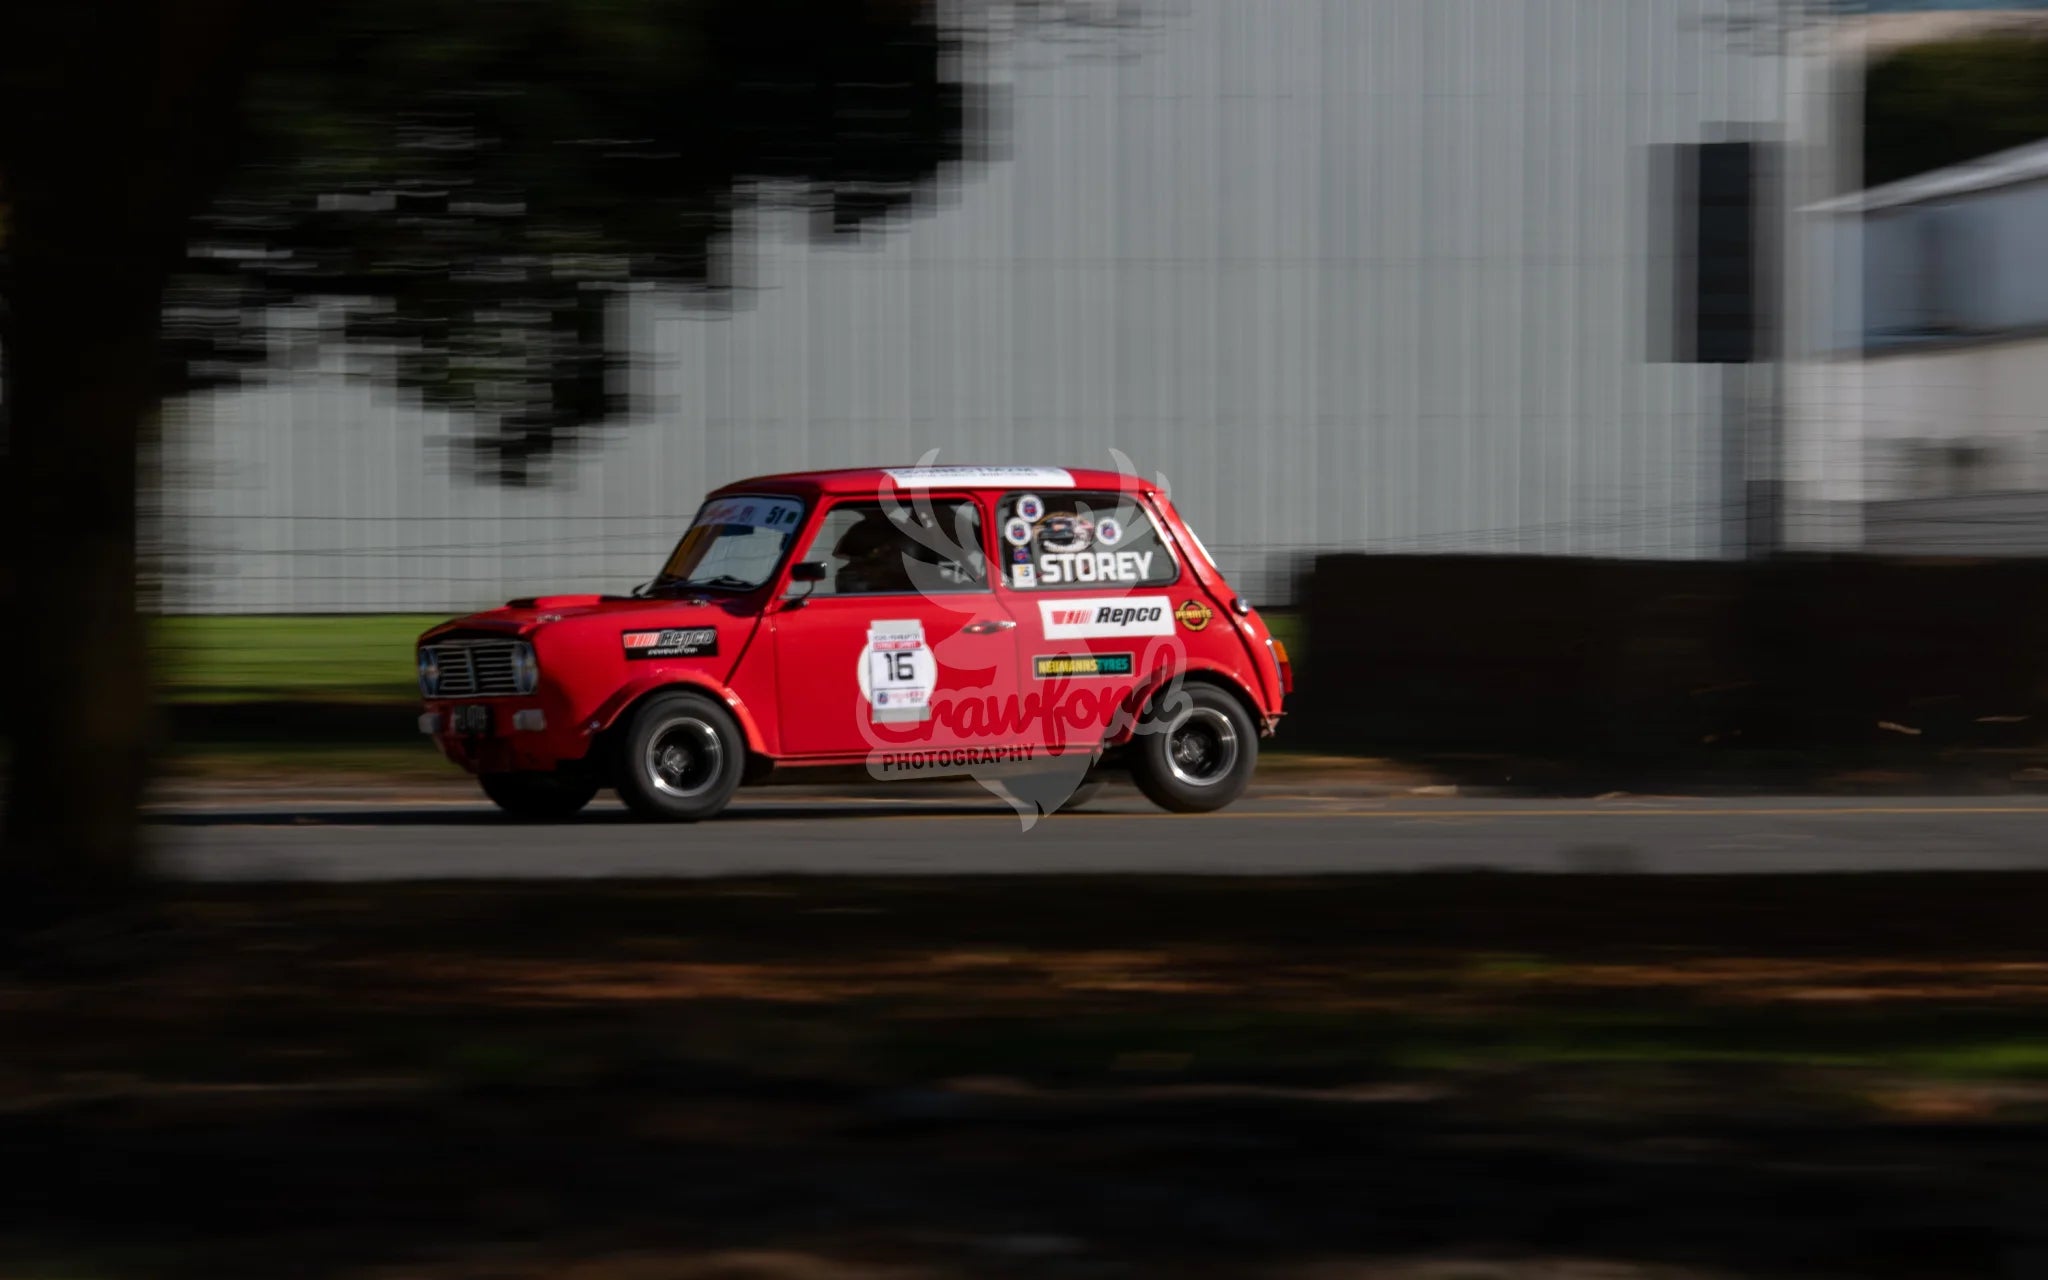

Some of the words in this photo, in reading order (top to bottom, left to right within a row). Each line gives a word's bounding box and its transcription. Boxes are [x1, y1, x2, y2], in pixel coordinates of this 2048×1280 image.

[765, 505, 787, 524] 51
[1040, 551, 1153, 583] STOREY
[1095, 606, 1162, 627] Repco
[659, 629, 717, 648] Repco
[883, 652, 914, 681] 16
